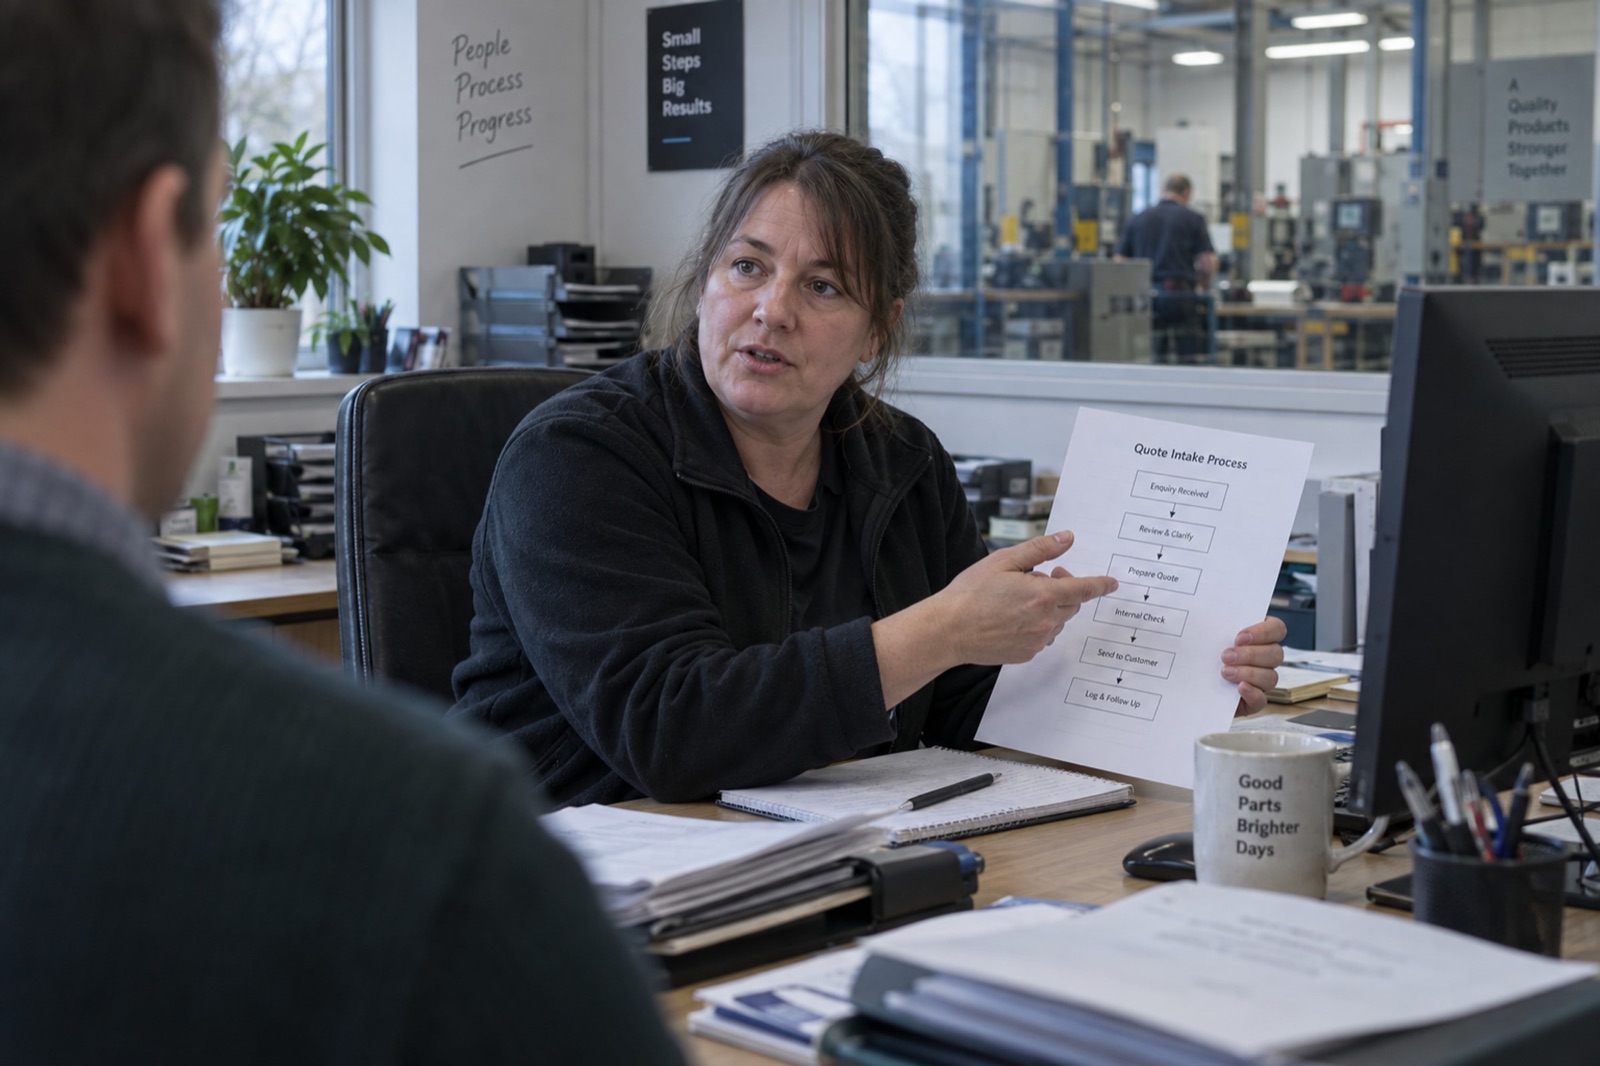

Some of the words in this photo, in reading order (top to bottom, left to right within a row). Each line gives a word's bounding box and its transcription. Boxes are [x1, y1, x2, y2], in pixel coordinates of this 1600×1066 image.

[662, 28, 701, 48] Small
[451, 28, 512, 70] People
[662, 54, 701, 73] Steps
[454, 71, 523, 104] Process
[662, 77, 685, 97] Big
[1508, 77, 1519, 92] A
[662, 99, 712, 117] Results
[1508, 98, 1558, 115] Quality
[456, 106, 532, 144] Progress
[1508, 119, 1570, 135] Products
[1508, 141, 1567, 159] Stronger
[1508, 163, 1567, 180] Together
[1134, 442, 1168, 459] Quote
[1170, 448, 1205, 464] Intake
[1207, 454, 1248, 470] Process
[1150, 482, 1177, 495] Enquiry
[1177, 485, 1210, 499] Received
[1139, 524, 1163, 537] Review
[1164, 528, 1170, 537] &
[1171, 529, 1194, 542] Clarify
[1128, 566, 1156, 579] Prepare
[1156, 571, 1180, 583] Quote
[1114, 608, 1143, 620] Internal
[1143, 613, 1166, 625] Check
[1097, 648, 1116, 660] Send
[1116, 652, 1124, 661] to
[1124, 654, 1159, 668] Customer
[1085, 689, 1099, 701] Log
[1099, 692, 1105, 700] &
[1106, 694, 1129, 706] Follow
[1130, 699, 1141, 709] Up
[1238, 774, 1283, 790] Good
[1238, 796, 1282, 813] Parts
[1237, 818, 1300, 838] Brighter
[1236, 840, 1275, 859] Days
